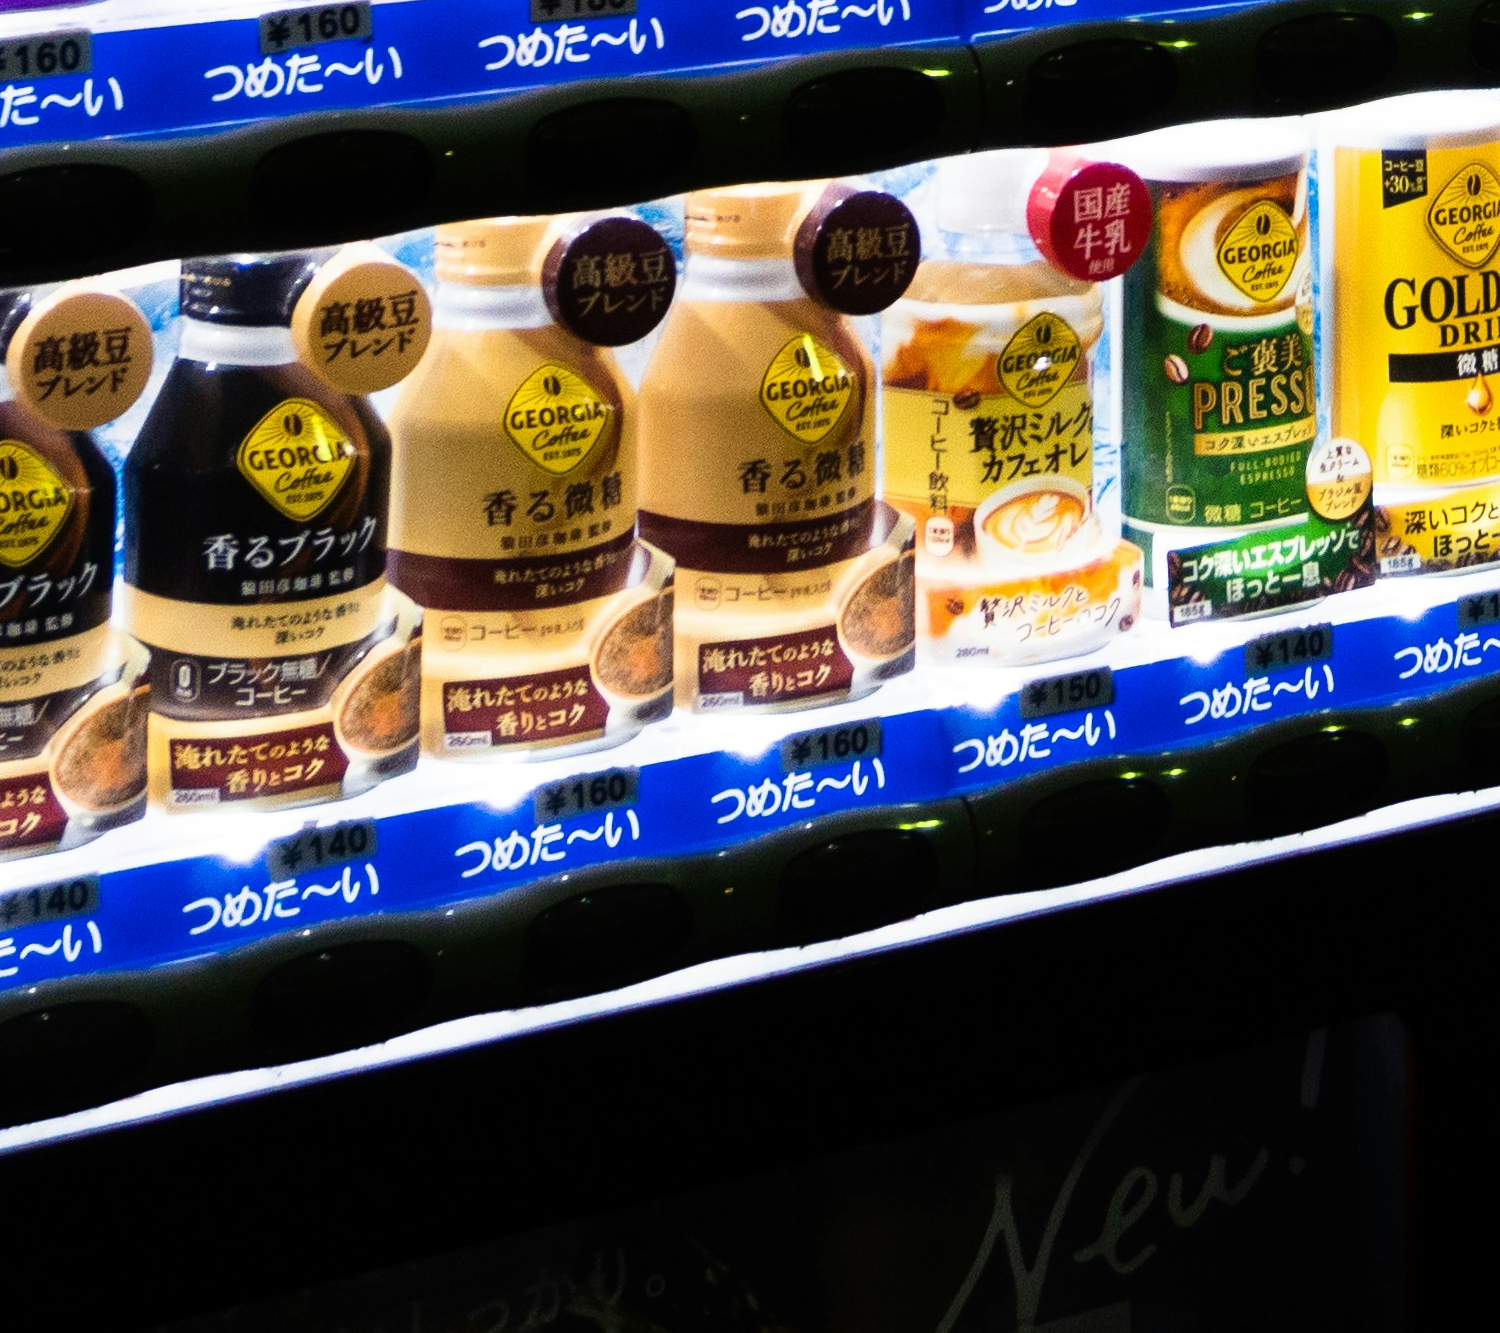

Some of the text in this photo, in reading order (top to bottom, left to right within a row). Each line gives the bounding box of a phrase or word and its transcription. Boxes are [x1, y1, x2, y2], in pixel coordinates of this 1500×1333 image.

[1074, 182, 1131, 224] 国産
[1073, 221, 1131, 257] 牛乳
[572, 247, 669, 290] 高級豆
[34, 328, 132, 374] 高級豆
[38, 367, 128, 401] ブレンド
[982, 443, 1088, 485] カフェオレ
[483, 472, 623, 528] 香る微糖
[1182, 528, 1362, 585] コク深いエスプレッソで
[1226, 562, 1321, 601] ほっと一息
[280, 824, 368, 870] ¥140
